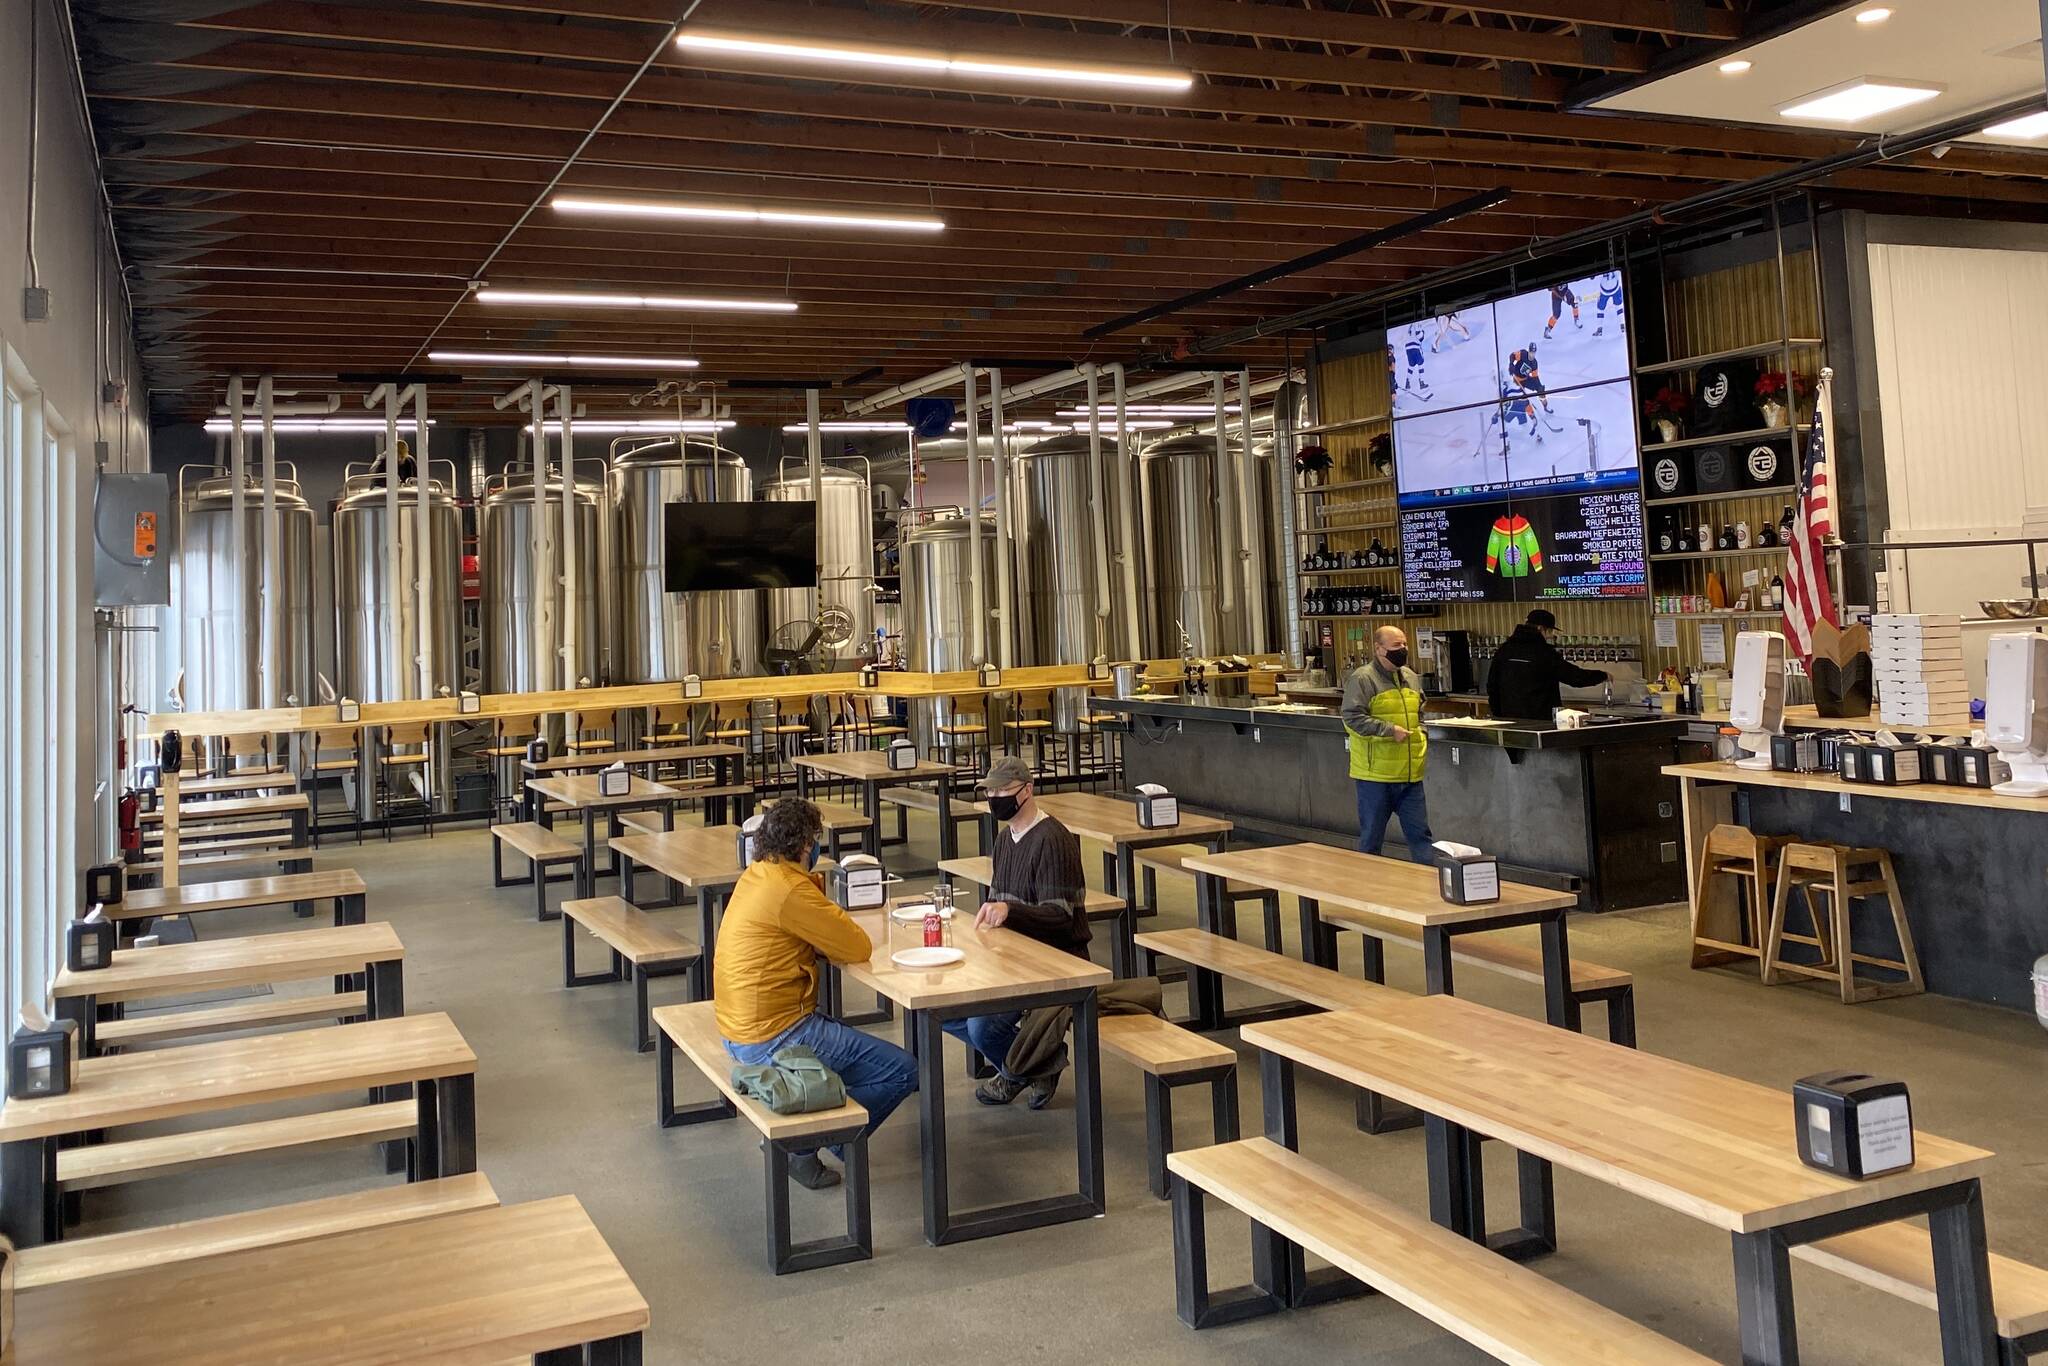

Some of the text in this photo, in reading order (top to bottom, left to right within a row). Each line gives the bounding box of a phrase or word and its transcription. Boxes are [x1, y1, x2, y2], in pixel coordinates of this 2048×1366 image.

[1580, 494, 1613, 505] MEXICAN
[1614, 492, 1639, 502] LAGER
[1427, 511, 1445, 519] BLOOM
[1581, 508, 1604, 516] CZECH
[1606, 504, 1640, 514] PILSNER
[1438, 520, 1449, 528] IPA
[1586, 518, 1610, 527] RAUCH
[1611, 515, 1640, 525] HELLES
[1403, 532, 1425, 540] ENIGMA
[1555, 531, 1592, 540] BAVARIAN
[1593, 527, 1642, 537] HEFEWEIZEN
[1404, 542, 1425, 550] CITRON
[1583, 541, 1611, 550] SMOKED
[1613, 539, 1642, 548] PORTER
[1440, 550, 1452, 558] IPA
[1550, 554, 1573, 562] NITRO
[1574, 552, 1616, 561] CHOCATE
[1618, 551, 1643, 559] STOUT
[1404, 562, 1423, 570] AMBER
[1424, 560, 1462, 568] KELLERBIER
[1600, 562, 1644, 571] GREYHOUND
[1558, 576, 1586, 584] WYLERS
[1587, 575, 1607, 583] DARK
[1615, 574, 1645, 582] STORMY
[1543, 586, 1645, 596] FRESH ORGANIC MARGARITA
